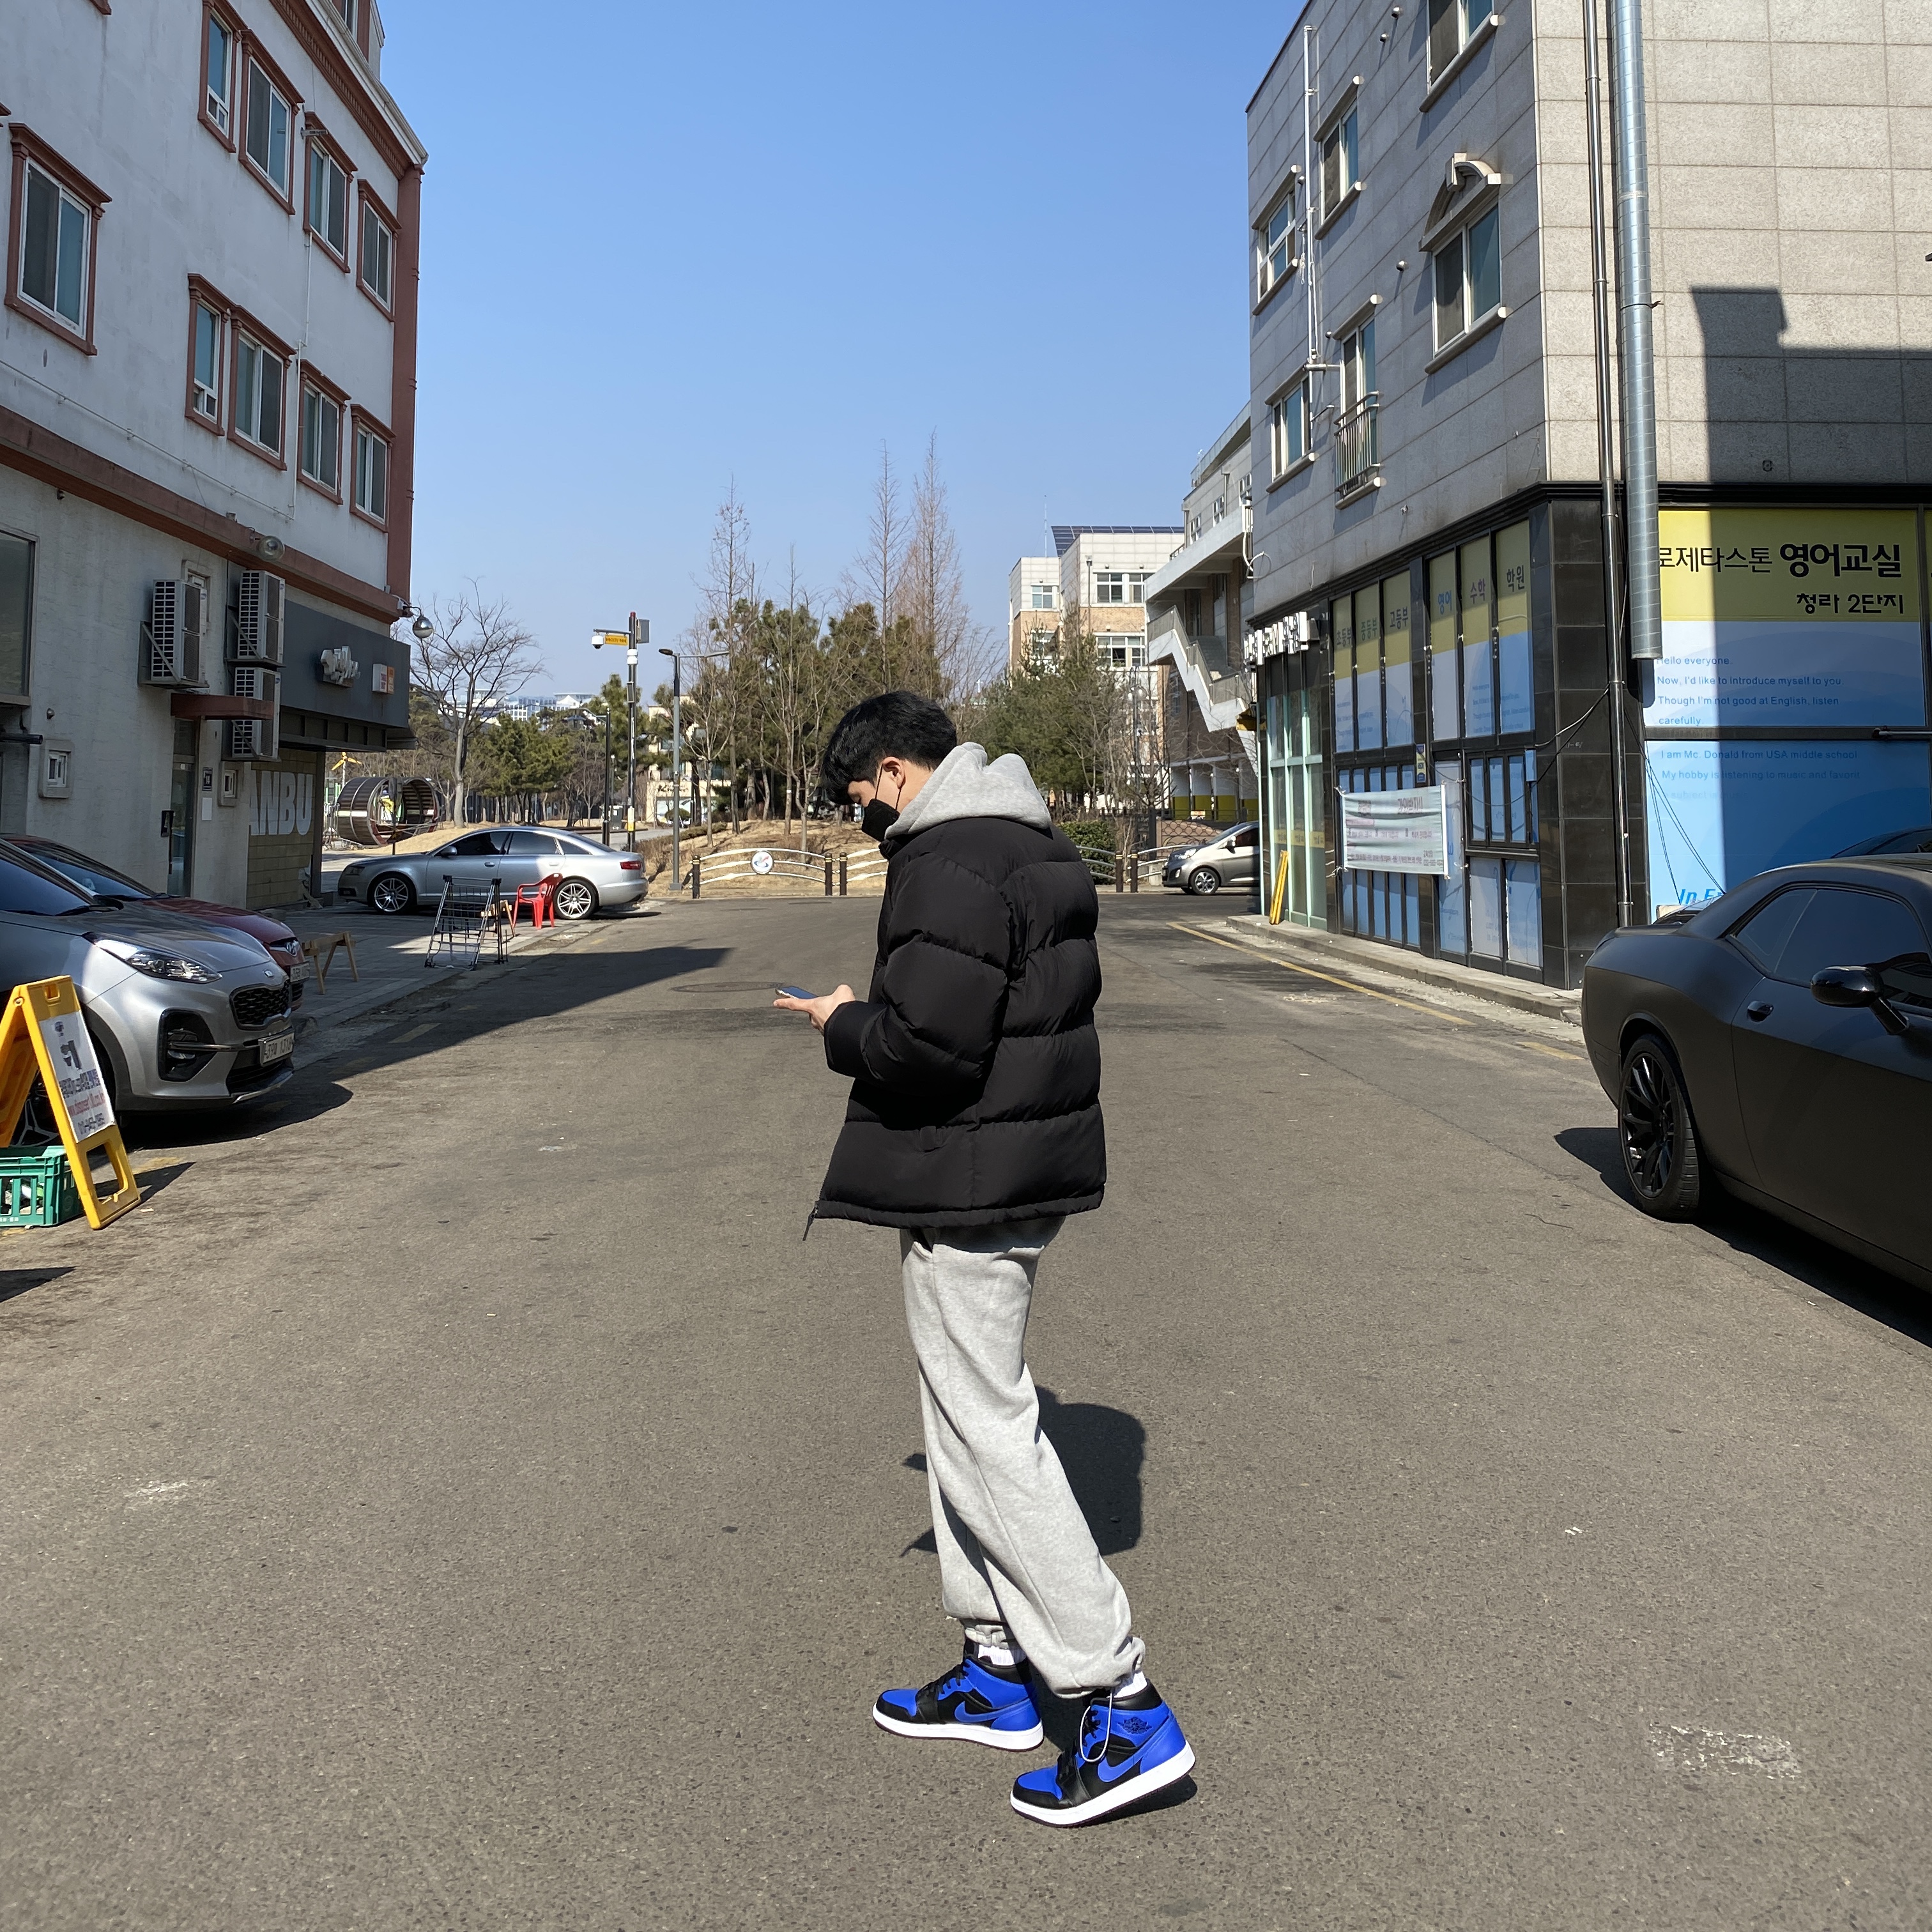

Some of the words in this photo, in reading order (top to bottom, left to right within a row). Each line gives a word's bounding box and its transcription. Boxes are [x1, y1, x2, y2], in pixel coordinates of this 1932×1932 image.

[1659, 548, 1773, 572] 로제타스톤
[1779, 543, 1902, 578] 영어교실
[1438, 590, 1452, 615] 영어
[1470, 578, 1485, 604] 수학
[1506, 565, 1525, 592] 학원
[1796, 593, 1840, 615] 청라
[1847, 594, 1904, 615] 2단지
[1336, 627, 1352, 647] 초등부
[1361, 617, 1377, 641] 중등부
[1390, 606, 1409, 629] 고등부
[1684, 657, 1733, 666] everyone.
[1657, 676, 1682, 686] Now,
[1685, 676, 1696, 685] I'd
[1699, 676, 1715, 685] like
[1718, 677, 1728, 685] to
[1729, 676, 1775, 685] introduce
[1778, 676, 1810, 687] myself
[1813, 677, 1821, 685] to
[1657, 696, 1695, 707] Though
[1698, 696, 1712, 705] I'm
[1715, 696, 1730, 705] not
[1732, 696, 1756, 707] good
[1759, 696, 1768, 705] at
[1770, 696, 1811, 707] English,
[1813, 696, 1839, 705] listen
[1684, 750, 1701, 759] Mc.
[1704, 750, 1738, 759] Donald
[1742, 750, 1763, 759] from
[1766, 750, 1788, 759] USA
[1790, 750, 1823, 759] middle
[1825, 750, 1857, 759] school
[1662, 770, 1676, 781] My
[1678, 770, 1709, 781] hobby
[1711, 770, 1719, 779] is
[1721, 770, 1763, 781] listening
[1766, 770, 1775, 779] to
[1777, 771, 1807, 779] music
[1809, 771, 1827, 779] and
[1680, 889, 1697, 904] In
